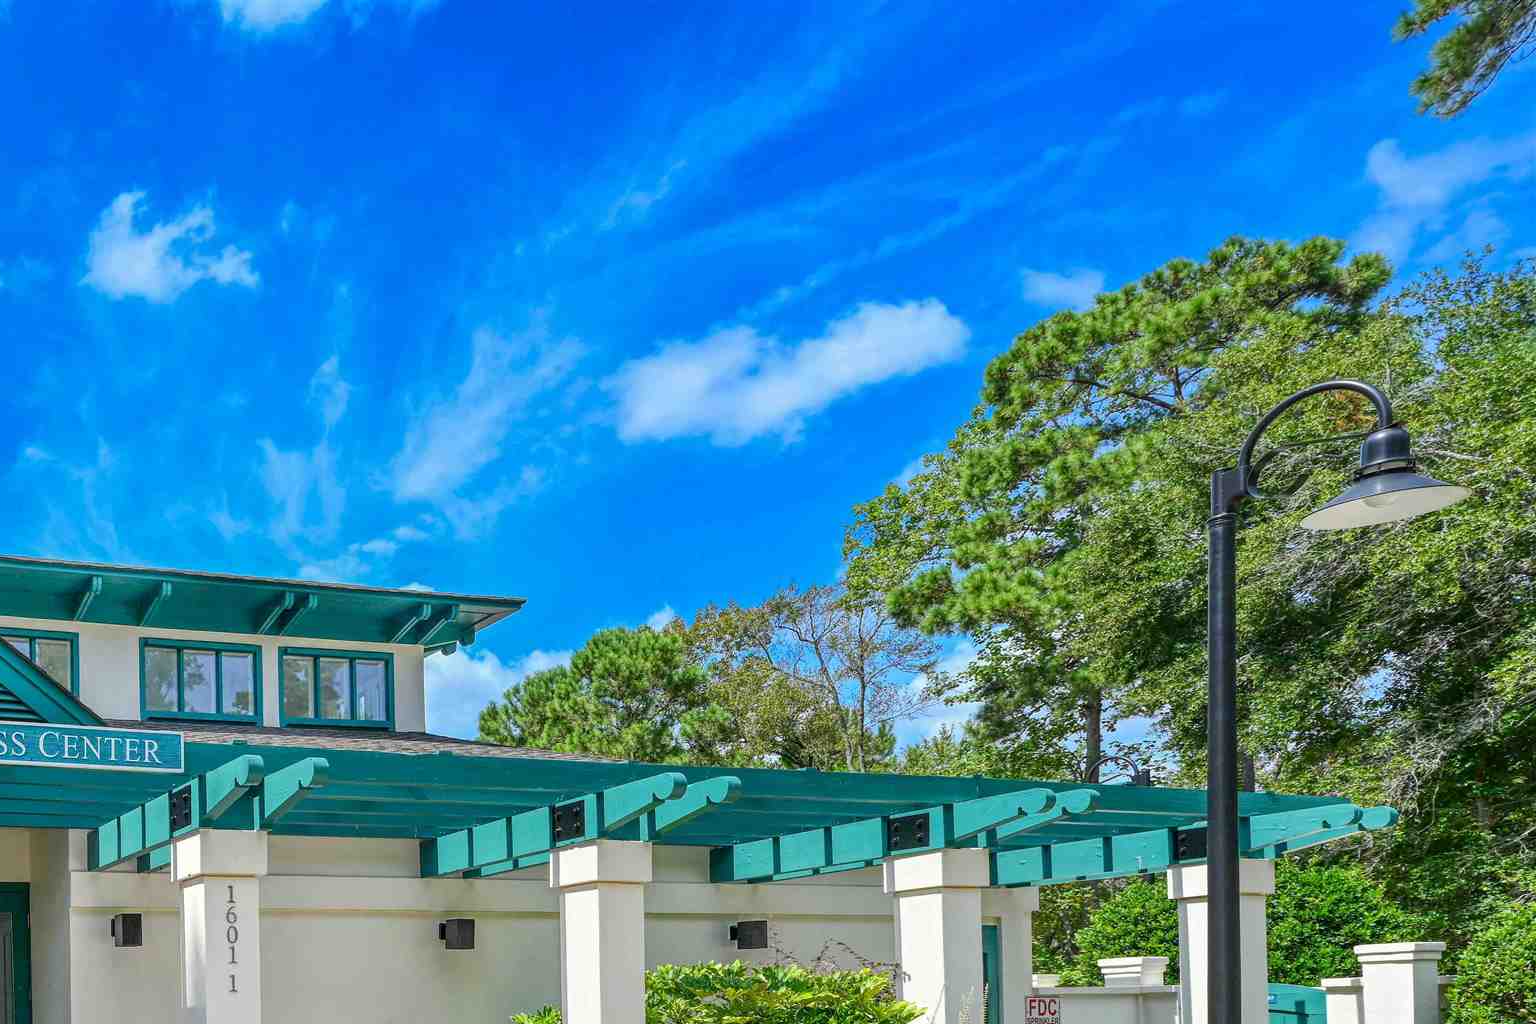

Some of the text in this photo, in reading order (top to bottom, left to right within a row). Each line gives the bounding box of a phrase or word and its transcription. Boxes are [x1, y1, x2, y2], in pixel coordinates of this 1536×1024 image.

[38, 731, 161, 763] CENTER
[226, 885, 238, 993] 16011
[1029, 999, 1057, 1016] FDC
